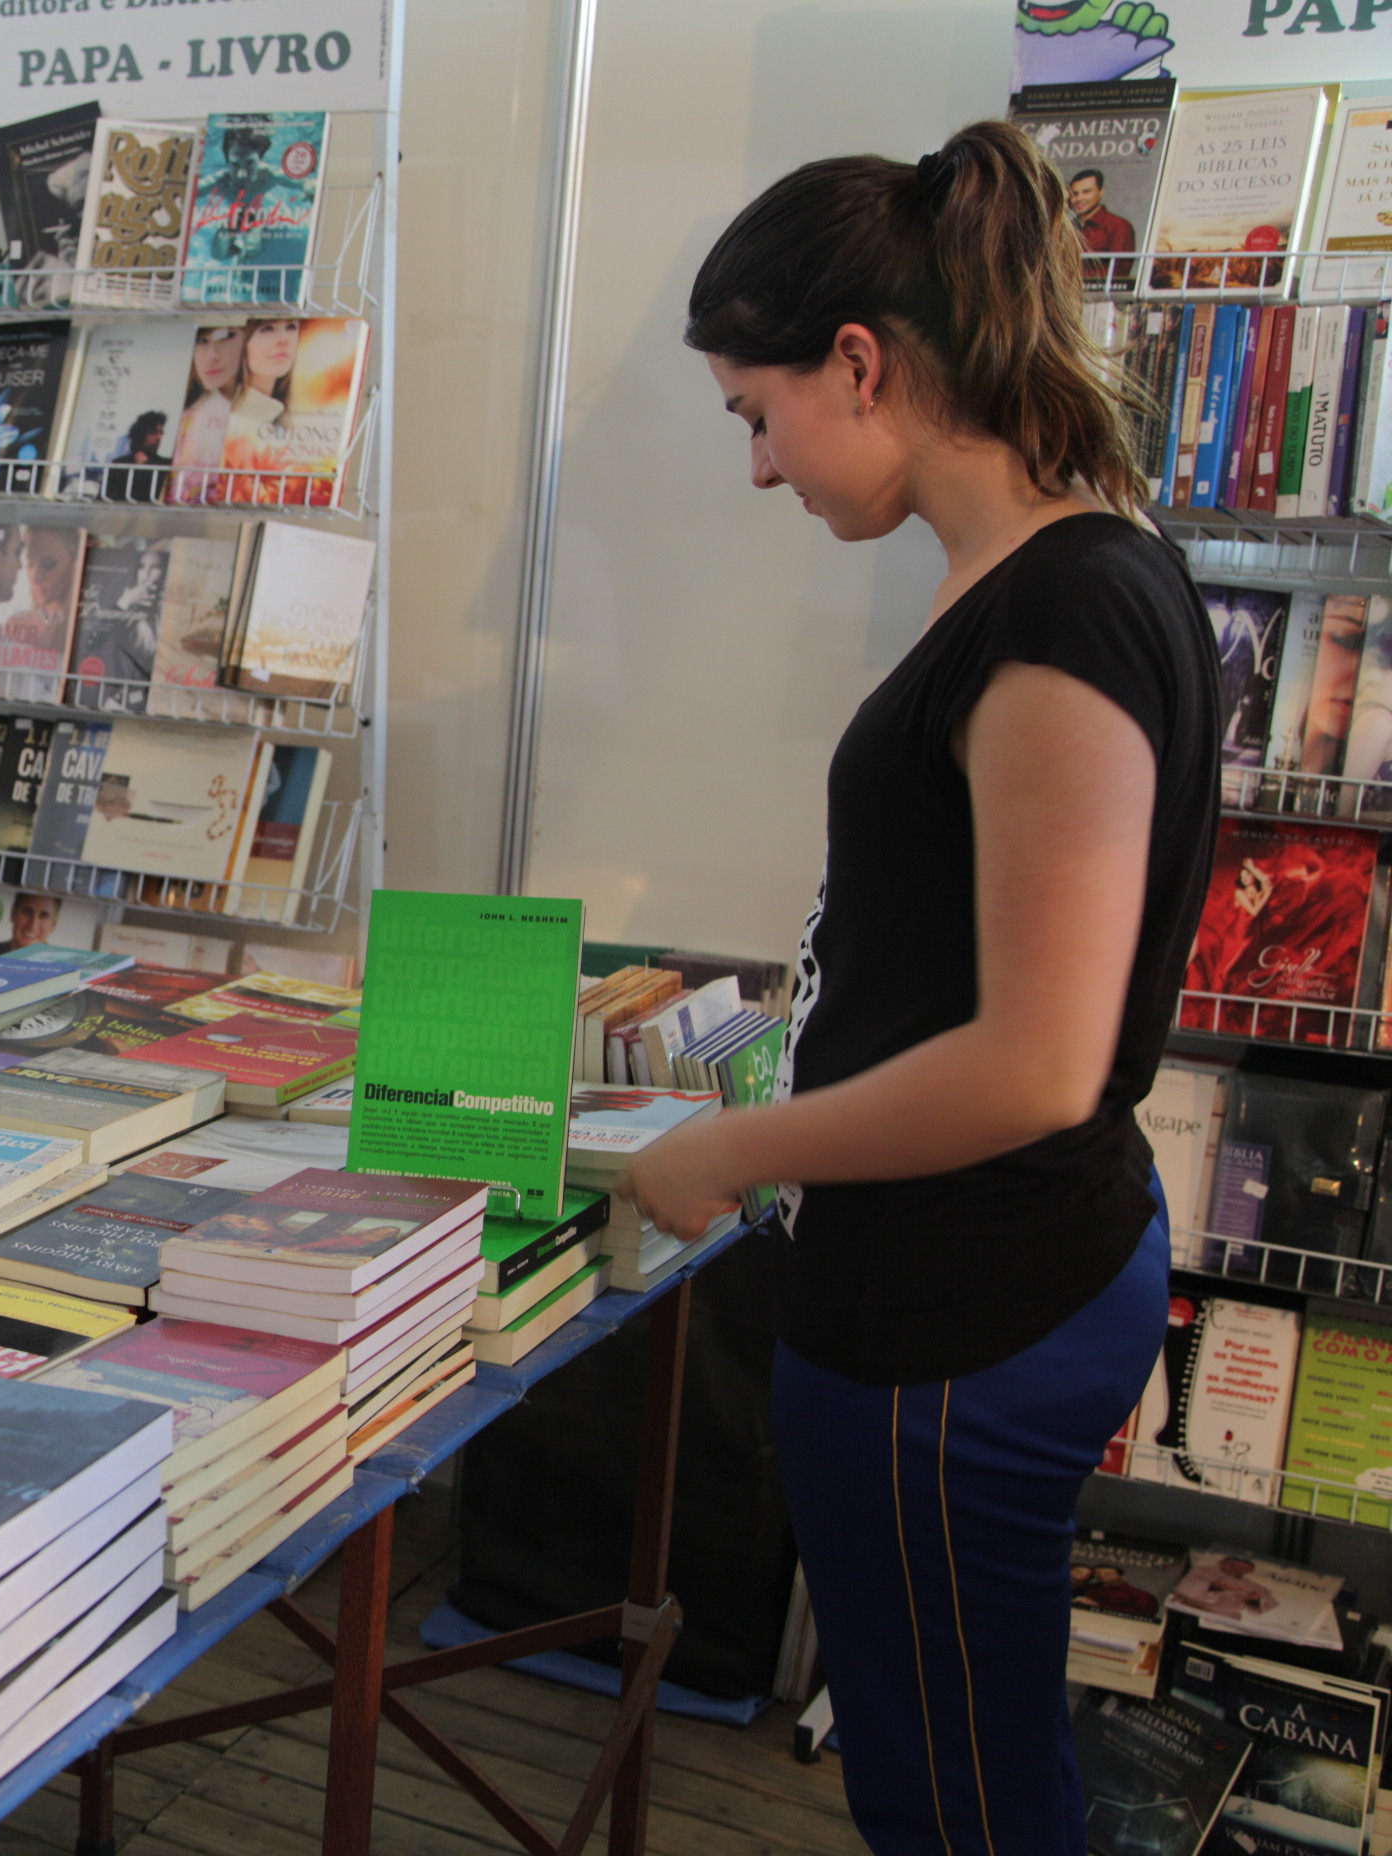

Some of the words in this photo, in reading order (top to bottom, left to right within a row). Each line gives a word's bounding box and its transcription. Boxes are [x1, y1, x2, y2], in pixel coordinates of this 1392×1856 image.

[19, 44, 143, 86] PAPA
[159, 60, 172, 70] -
[187, 31, 350, 77] LIVRO
[1194, 142, 1216, 156] AS
[1221, 141, 1242, 154] 25
[1250, 136, 1288, 151] LEIS
[1196, 154, 1278, 174] BÍBLICAS
[1177, 180, 1205, 193] DO
[1212, 173, 1292, 191] SUCESSO
[1308, 400, 1330, 467] MATUTO
[12, 780, 29, 802] DE
[56, 781, 73, 802] DE
[479, 913, 505, 921] JOHN
[521, 915, 568, 924] NESHEIM
[73, 1021, 96, 1033] do
[91, 1014, 104, 1024] A
[1139, 1107, 1202, 1136] Ágape
[366, 1168, 402, 1177] SEGREDO
[405, 1171, 424, 1179] PARA
[46, 1219, 126, 1240] HIGGINS
[98, 1222, 157, 1237] CLARK
[11, 1241, 89, 1263] HIGGINS
[59, 1242, 116, 1260] CLARK
[91, 1259, 143, 1275] MARY
[26, 1297, 45, 1306] van
[47, 1298, 120, 1323] Hensbergen
[1224, 1339, 1245, 1350] Por
[1248, 1344, 1271, 1356] que
[1313, 1339, 1358, 1358] COM
[1364, 1349, 1379, 1361] O
[1213, 1352, 1227, 1360] os
[1231, 1353, 1278, 1370] homens
[1226, 1364, 1263, 1378] amam
[1206, 1373, 1220, 1381] as
[1223, 1375, 1279, 1393] mulheres
[1206, 1385, 1276, 1405] poderosas?
[1291, 1703, 1307, 1721] A
[1239, 1704, 1357, 1759] CABANA
